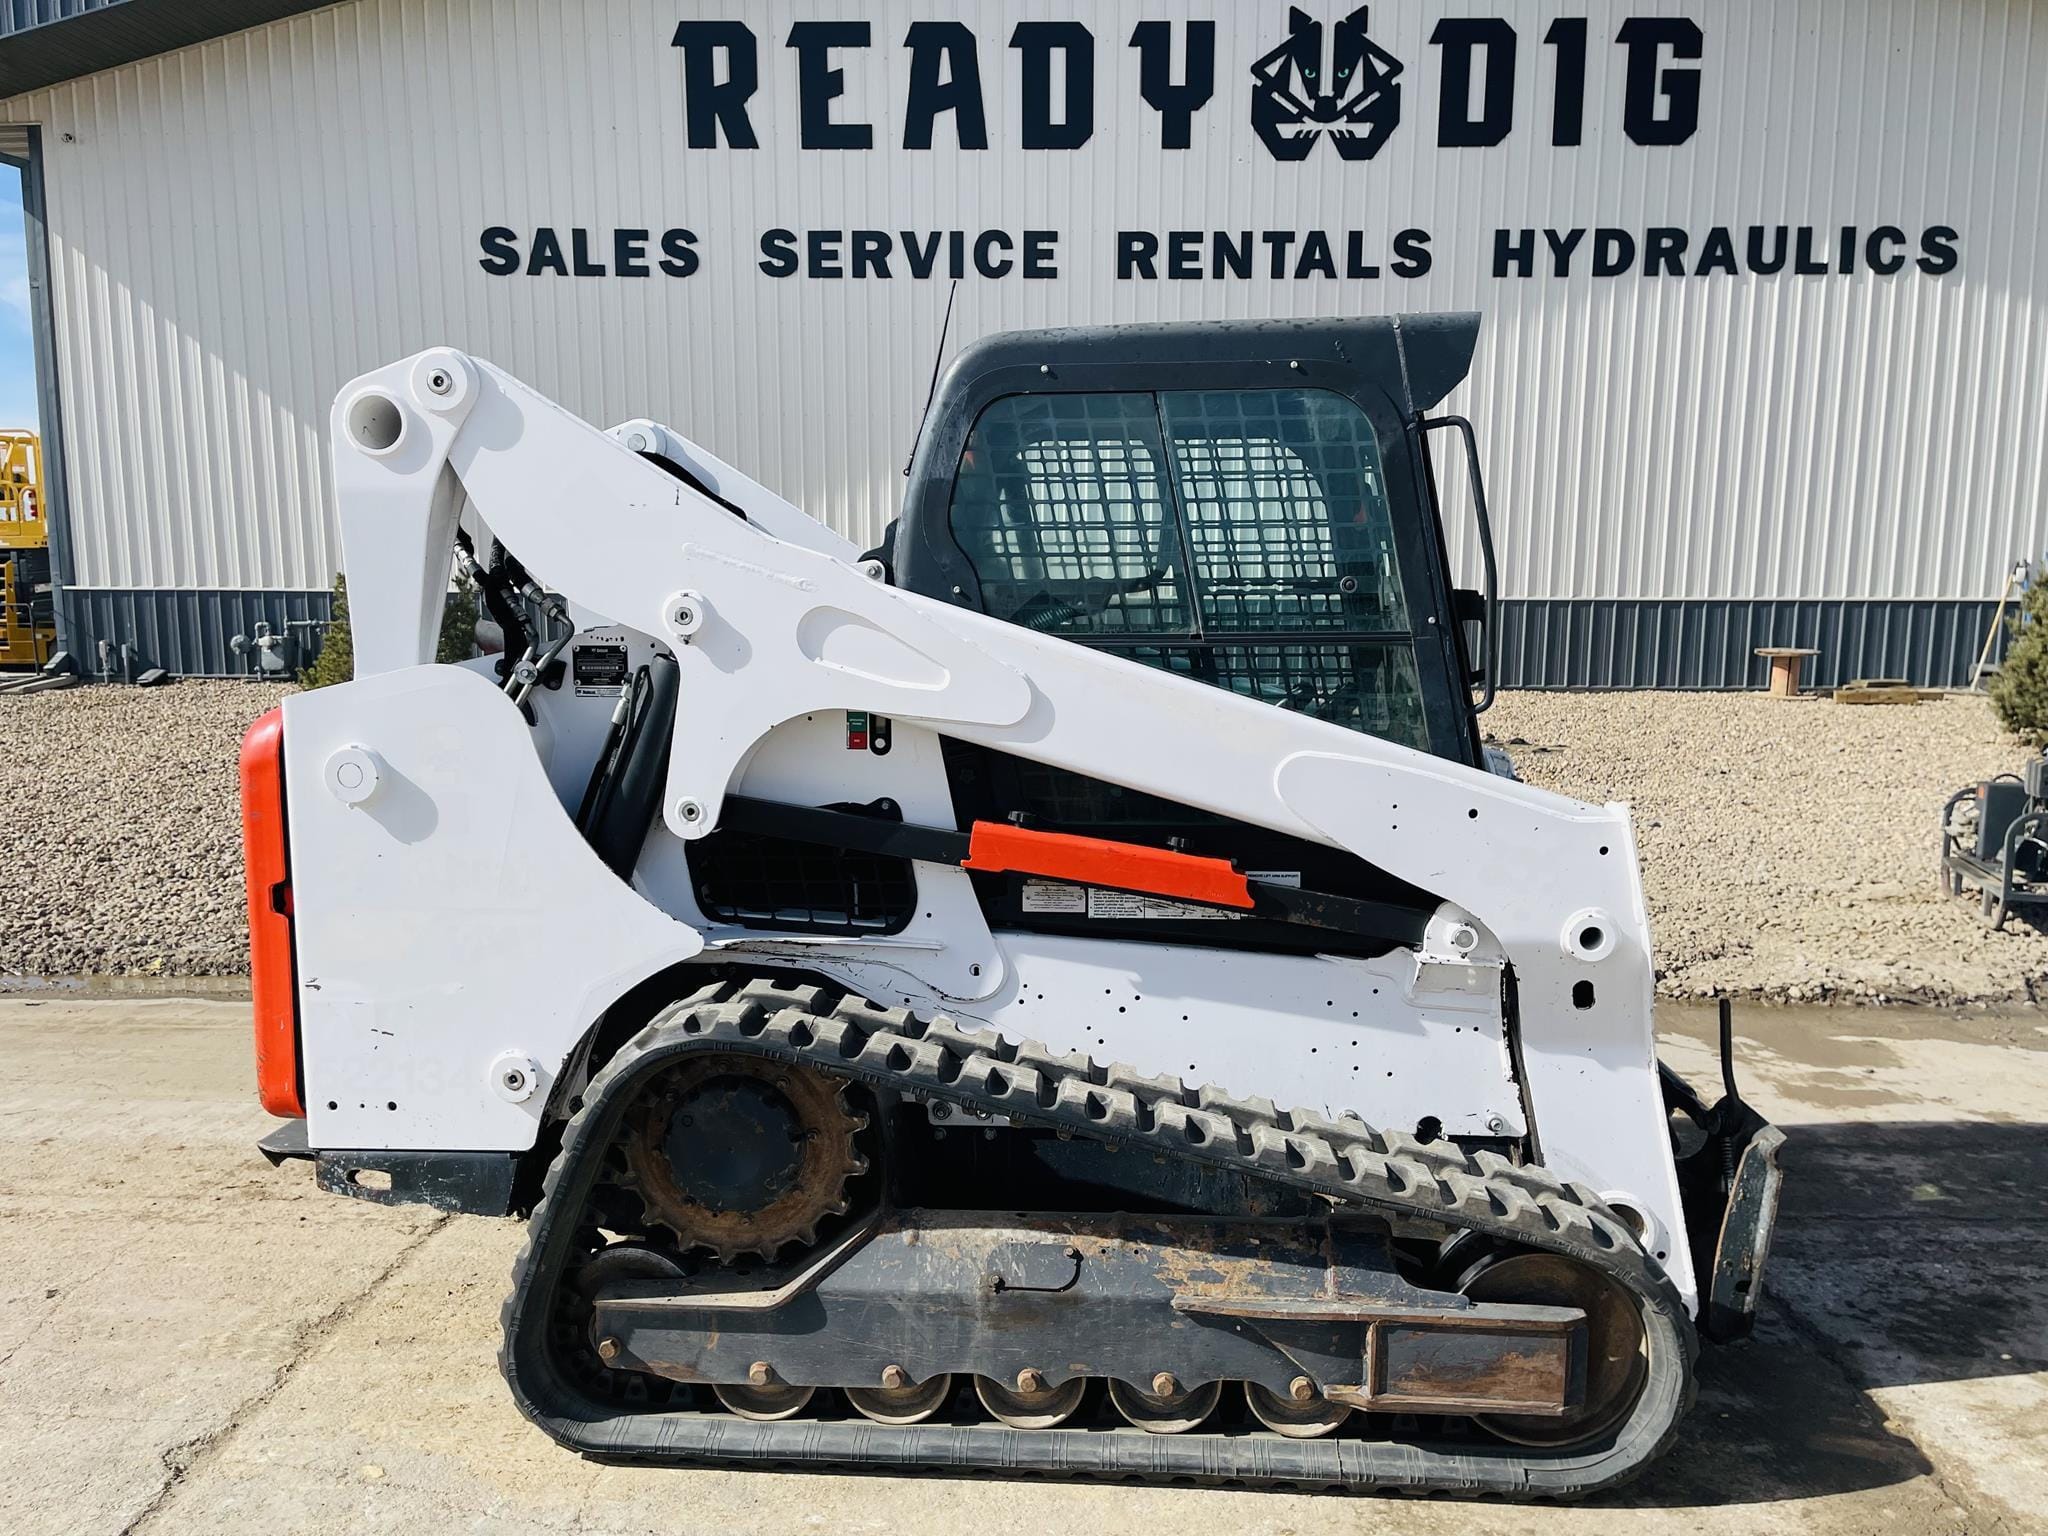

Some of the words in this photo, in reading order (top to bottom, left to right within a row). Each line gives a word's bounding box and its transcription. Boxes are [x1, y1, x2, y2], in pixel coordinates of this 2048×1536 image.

[671, 21, 1215, 149] READY
[1429, 18, 1703, 147] DIG
[480, 227, 699, 278] SALES
[759, 229, 1058, 279] SERVICE
[1118, 229, 1431, 279] RENTALS
[1493, 225, 1958, 278] HYDRAULICS
